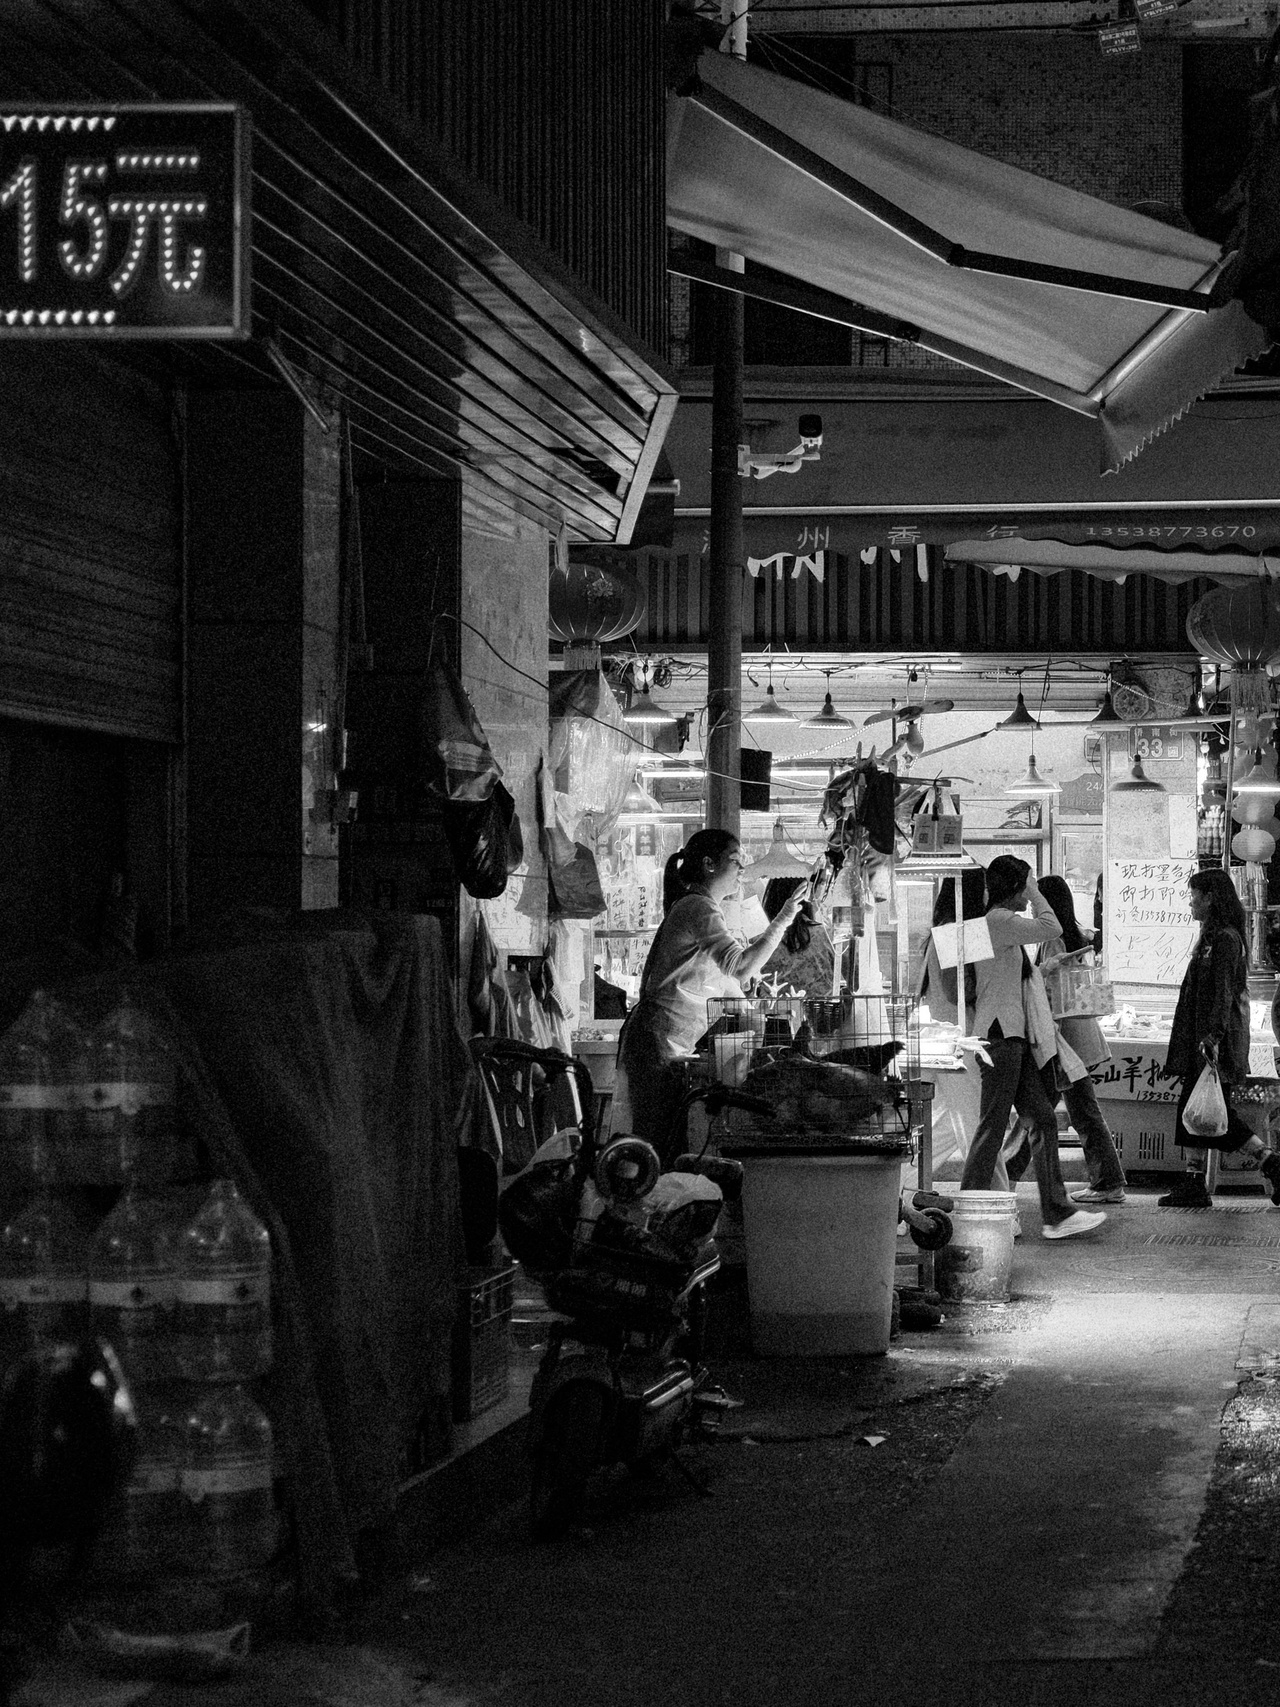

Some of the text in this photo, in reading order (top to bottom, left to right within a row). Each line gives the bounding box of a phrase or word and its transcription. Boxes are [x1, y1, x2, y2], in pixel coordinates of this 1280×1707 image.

[0, 148, 207, 294] 15元
[1086, 525, 1256, 538] 13538773670
[1137, 738, 1163, 758] 33
